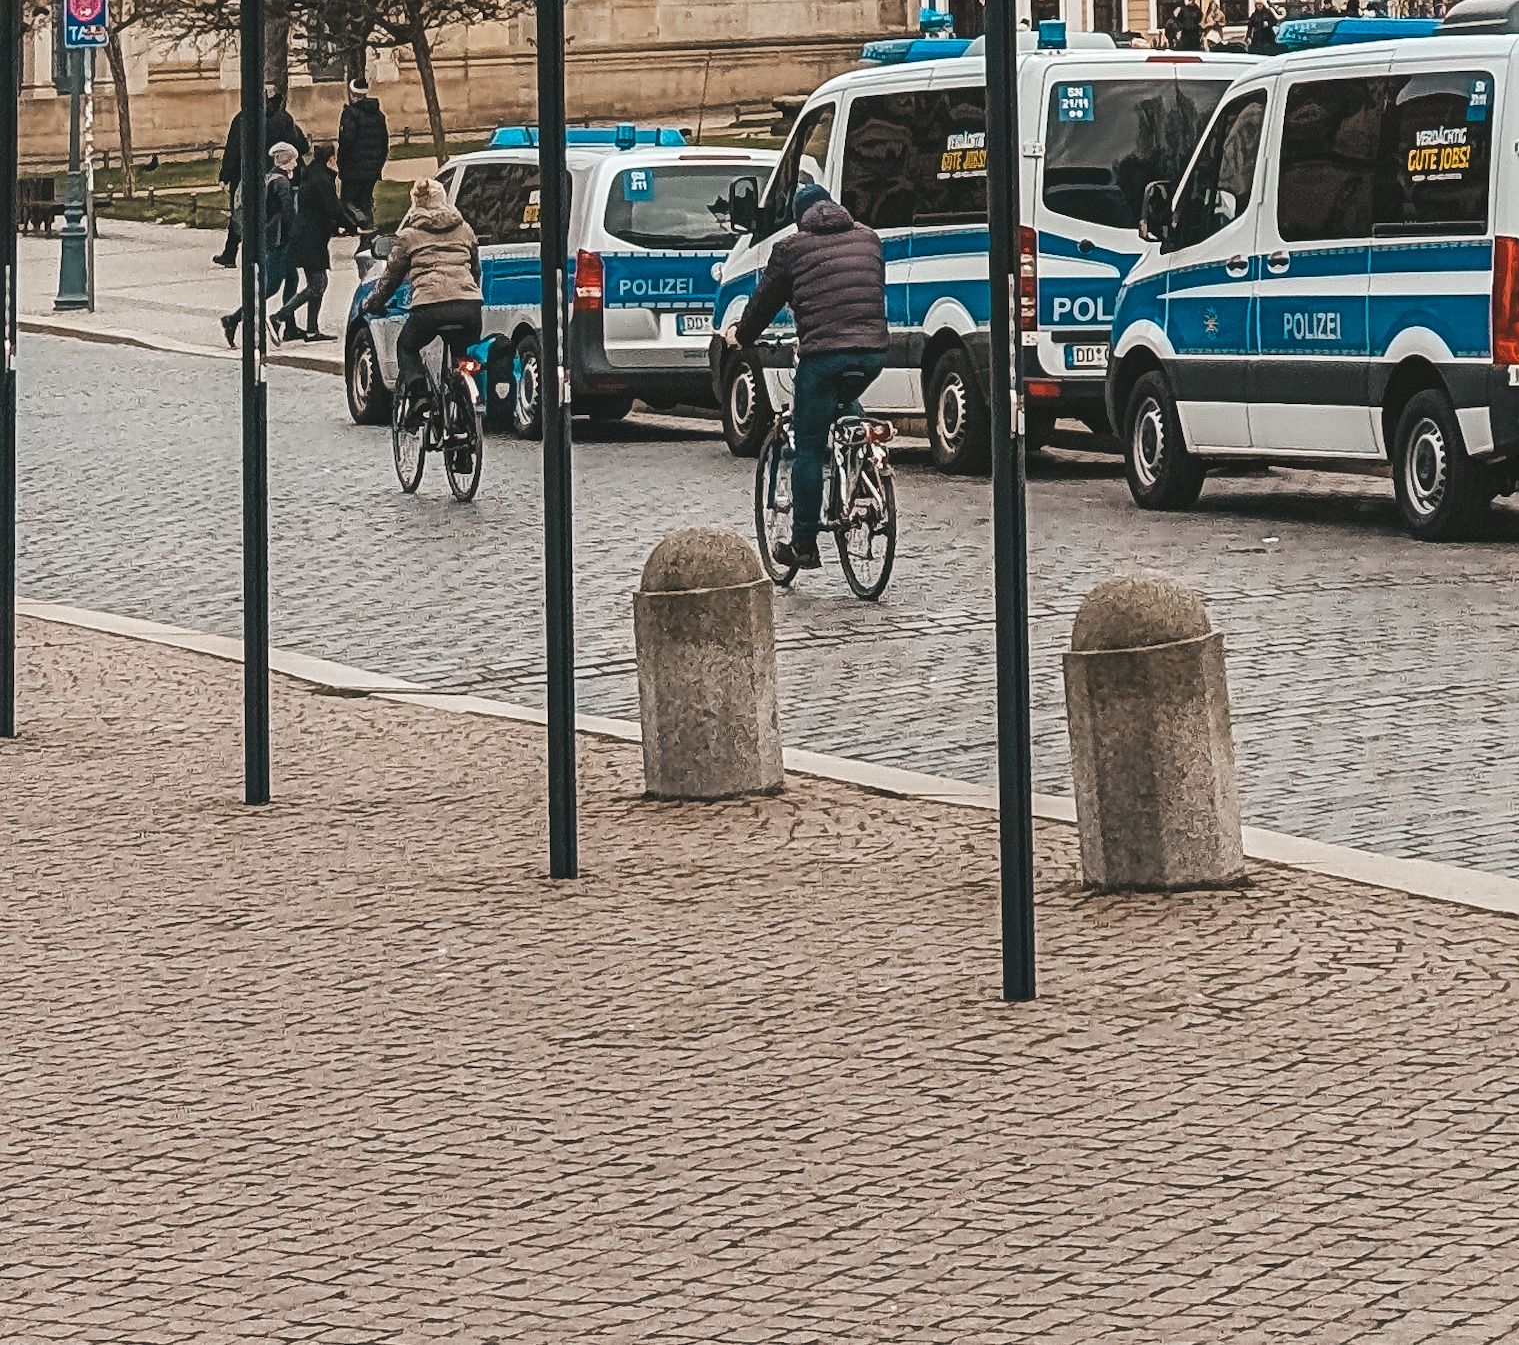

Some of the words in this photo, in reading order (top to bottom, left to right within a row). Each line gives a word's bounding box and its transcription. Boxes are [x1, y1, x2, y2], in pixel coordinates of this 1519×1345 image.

[1408, 147, 1439, 172] GUTE
[619, 277, 694, 296] POLIZEI
[1052, 296, 1115, 322] POL
[1283, 312, 1342, 340] POLIZEI
